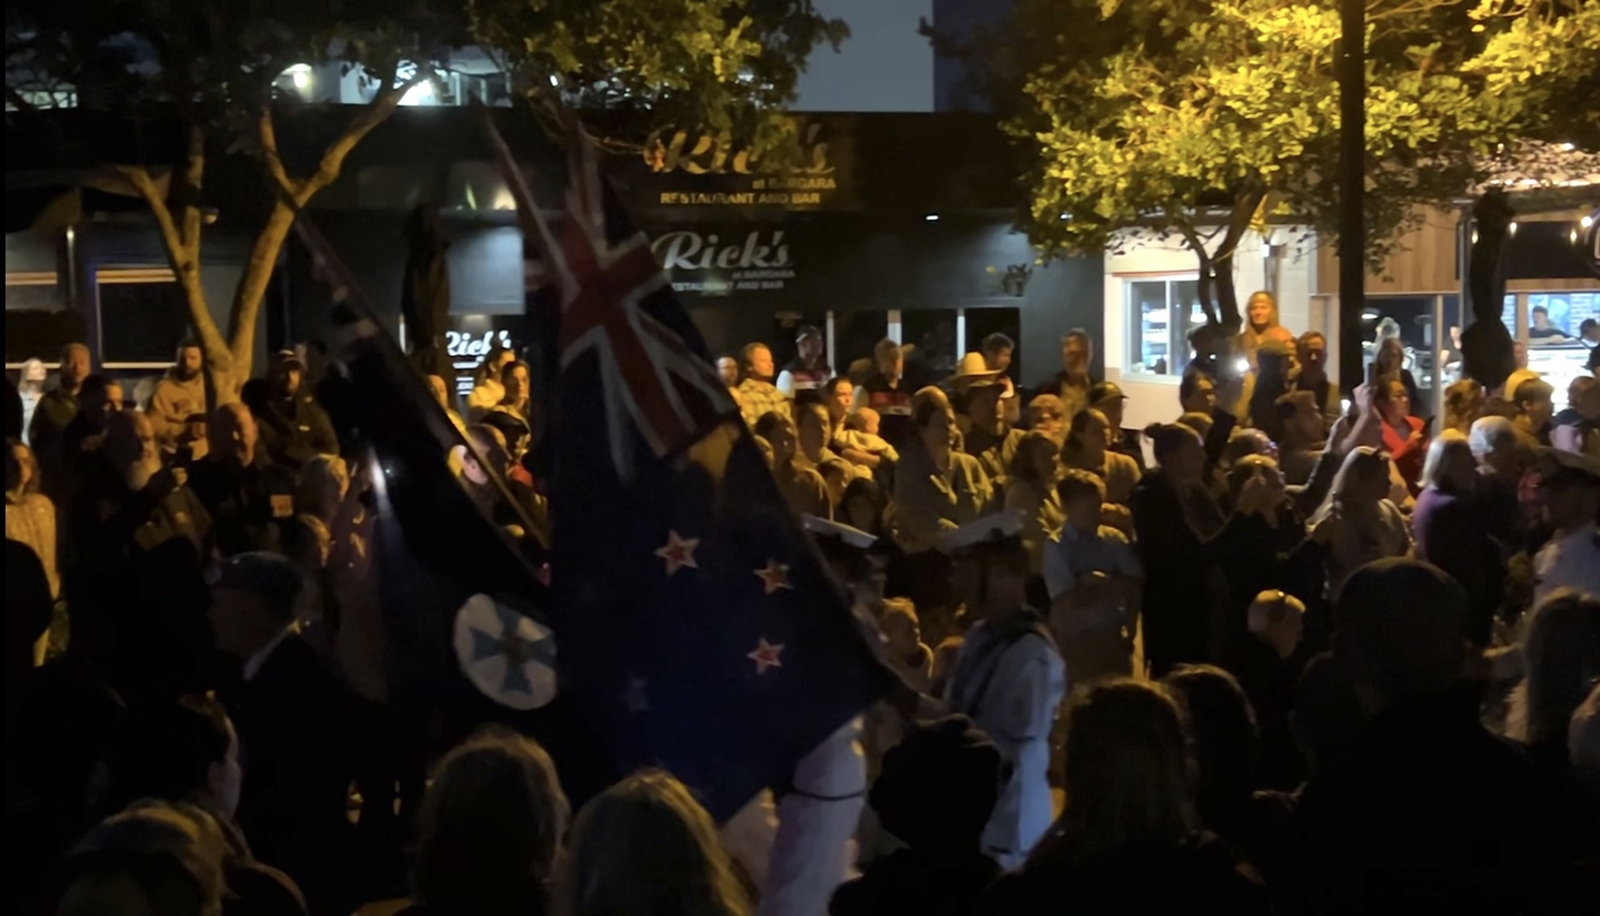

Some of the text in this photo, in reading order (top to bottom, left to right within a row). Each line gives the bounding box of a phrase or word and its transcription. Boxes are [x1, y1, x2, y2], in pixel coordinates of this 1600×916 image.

[659, 192, 821, 205] RESTAURANT AND BAR
[651, 230, 793, 270] Rick's
